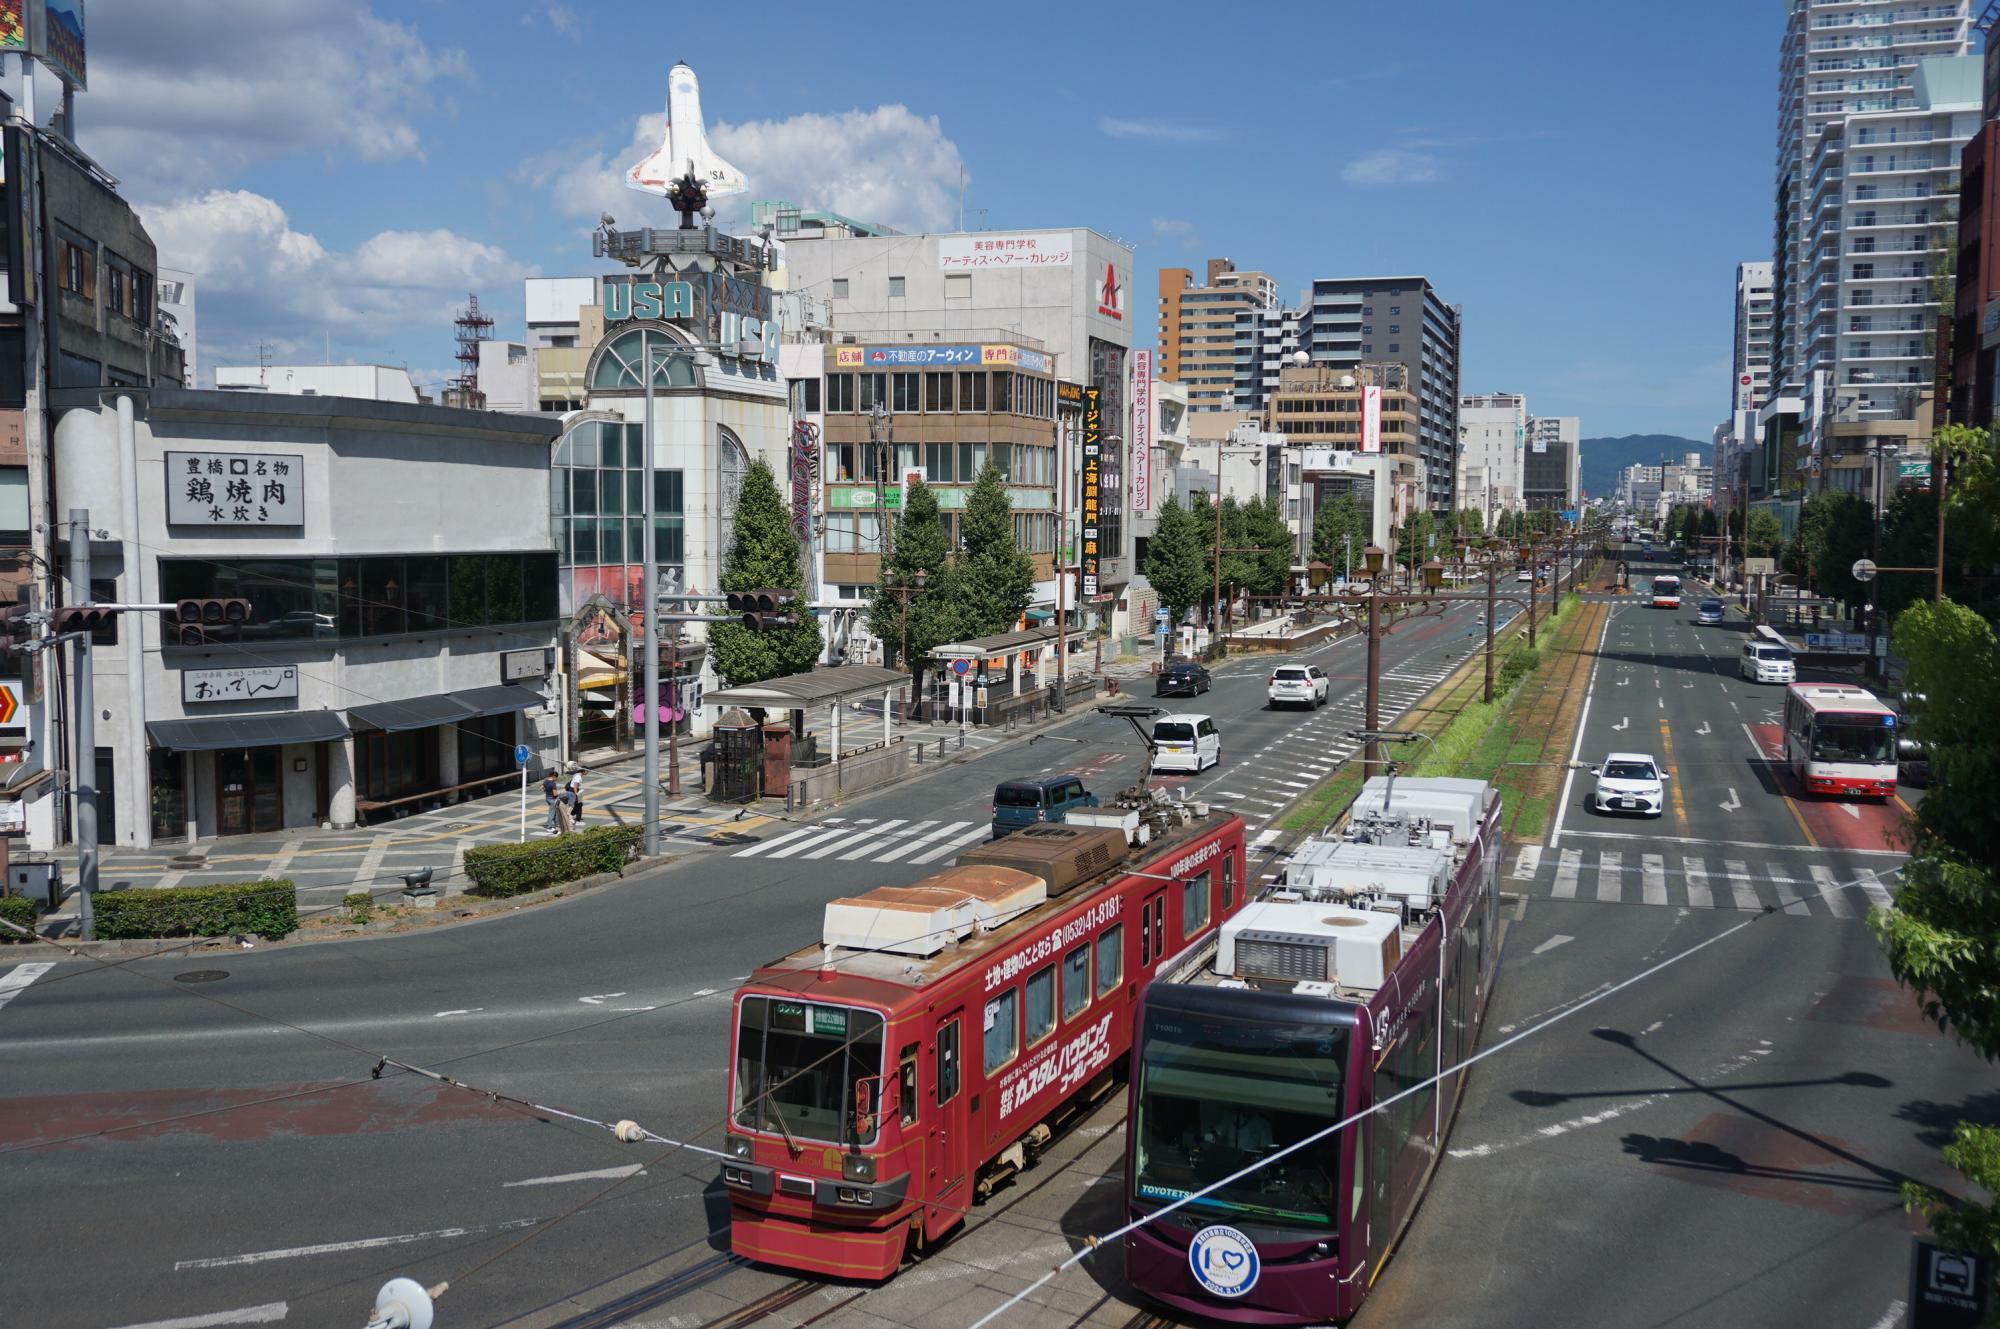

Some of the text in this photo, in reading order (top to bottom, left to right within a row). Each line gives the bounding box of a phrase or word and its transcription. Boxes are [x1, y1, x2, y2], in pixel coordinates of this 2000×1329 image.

[975, 239, 1037, 251] 美容専門学校
[942, 251, 1070, 266] アーティス・ヘアー・カレッジ
[603, 281, 694, 320] USA
[720, 311, 782, 365] USA
[839, 348, 1008, 363] 店舗 不動産のアーウィン 専門
[1136, 352, 1147, 406] 美容専門学校
[1086, 390, 1099, 443] マージャン
[187, 457, 289, 476] 豊橋 名物
[186, 477, 286, 505] 鶏焼肉
[208, 505, 269, 522] 水炊き
[194, 674, 282, 699] おいでん
[1062, 894, 1120, 947] (0532)41-8181
[777, 1003, 803, 1016] ワンマン
[1015, 1011, 1113, 1109] カスタムハウジング
